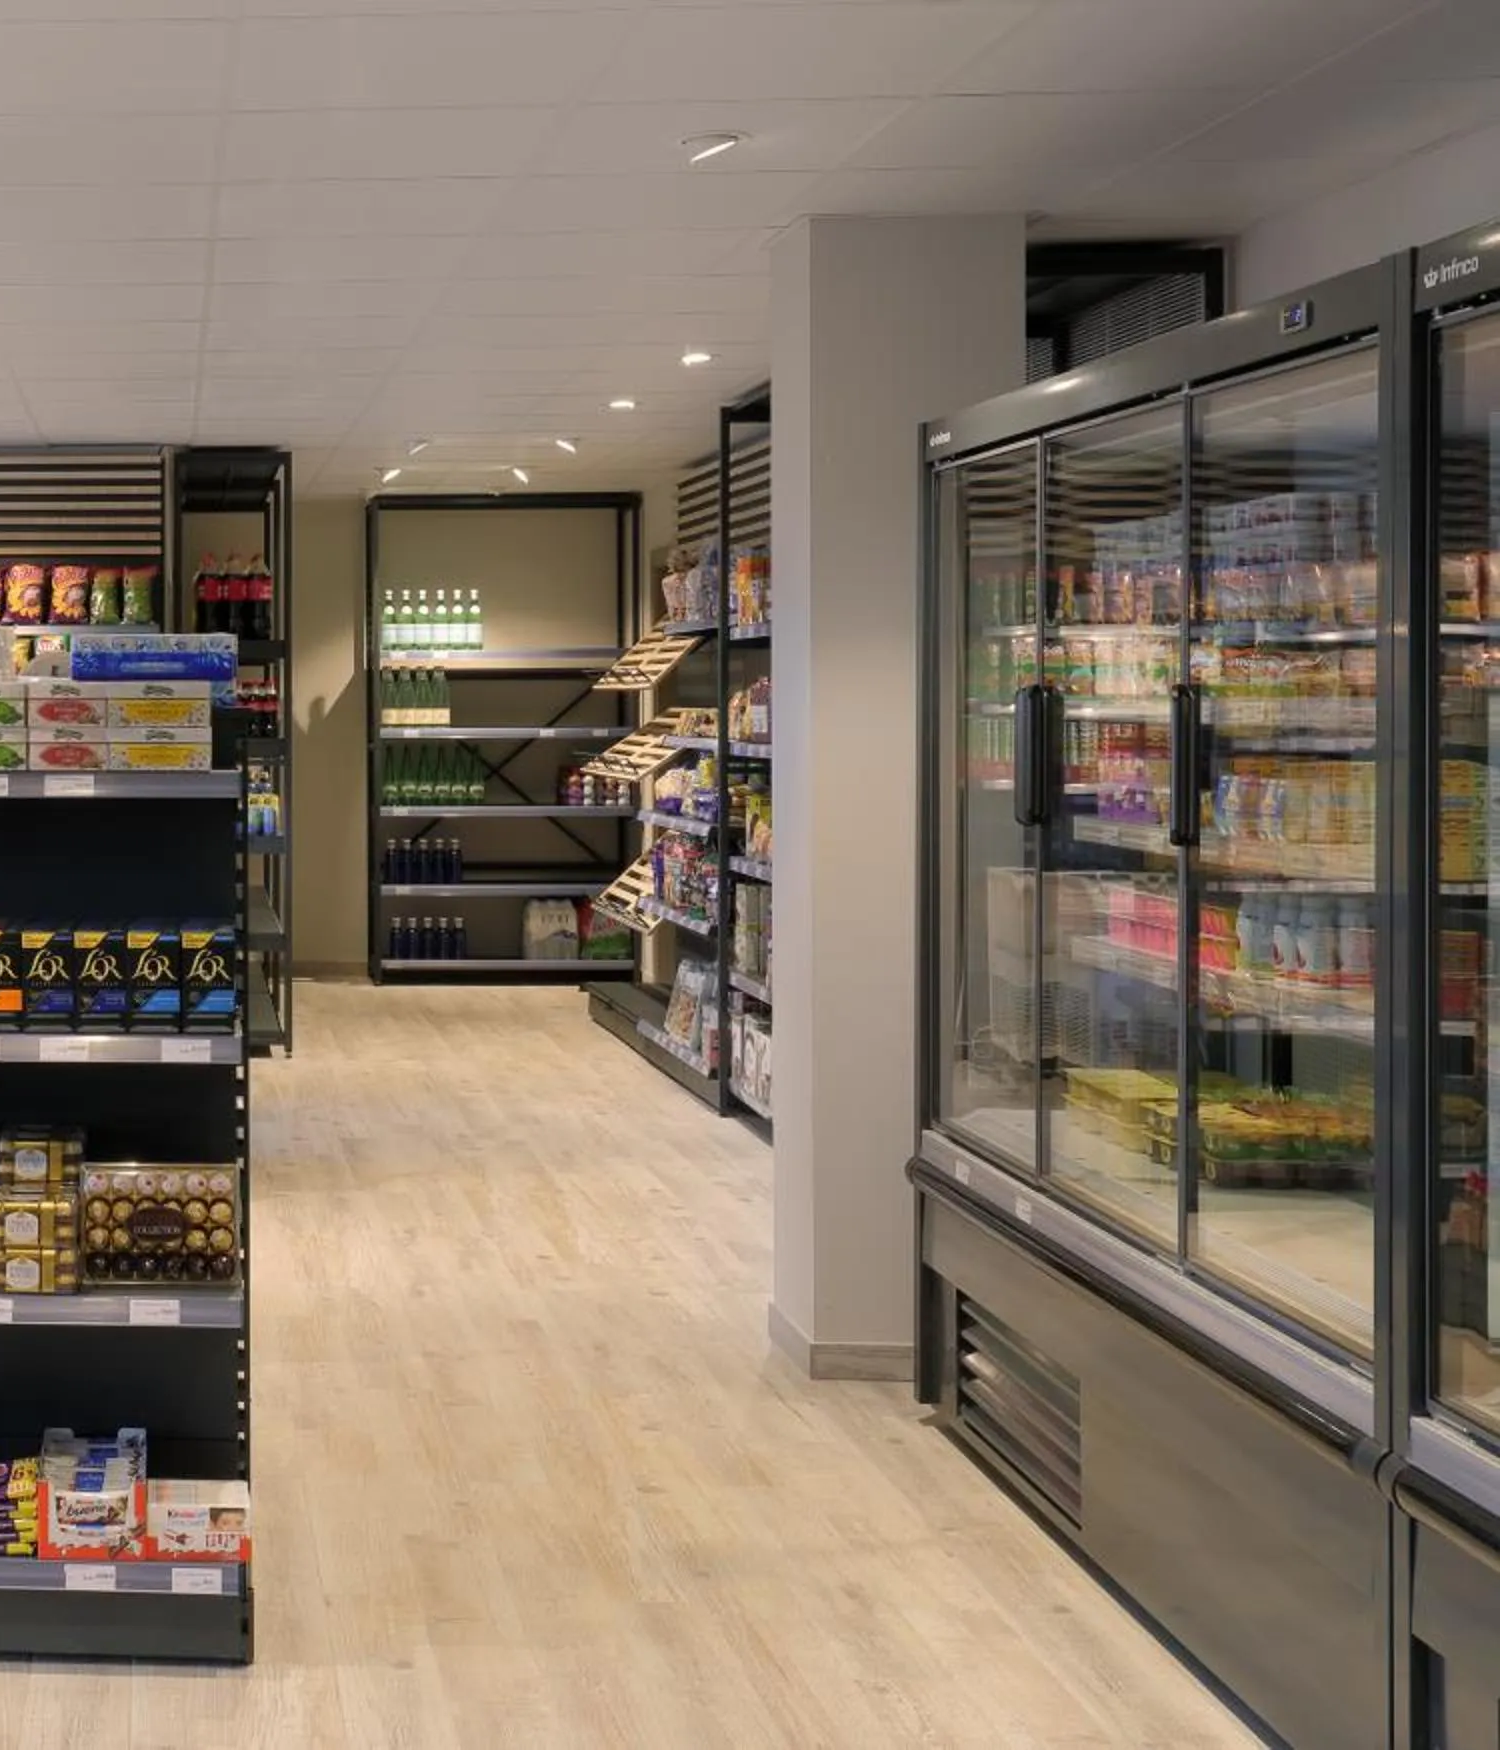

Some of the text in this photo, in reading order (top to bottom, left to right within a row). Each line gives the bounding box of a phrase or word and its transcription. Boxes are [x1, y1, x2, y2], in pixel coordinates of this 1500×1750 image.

[25, 949, 71, 981] L'OR
[78, 948, 123, 981] L'OR
[131, 948, 179, 981] L'OR
[185, 949, 232, 981] L'OR
